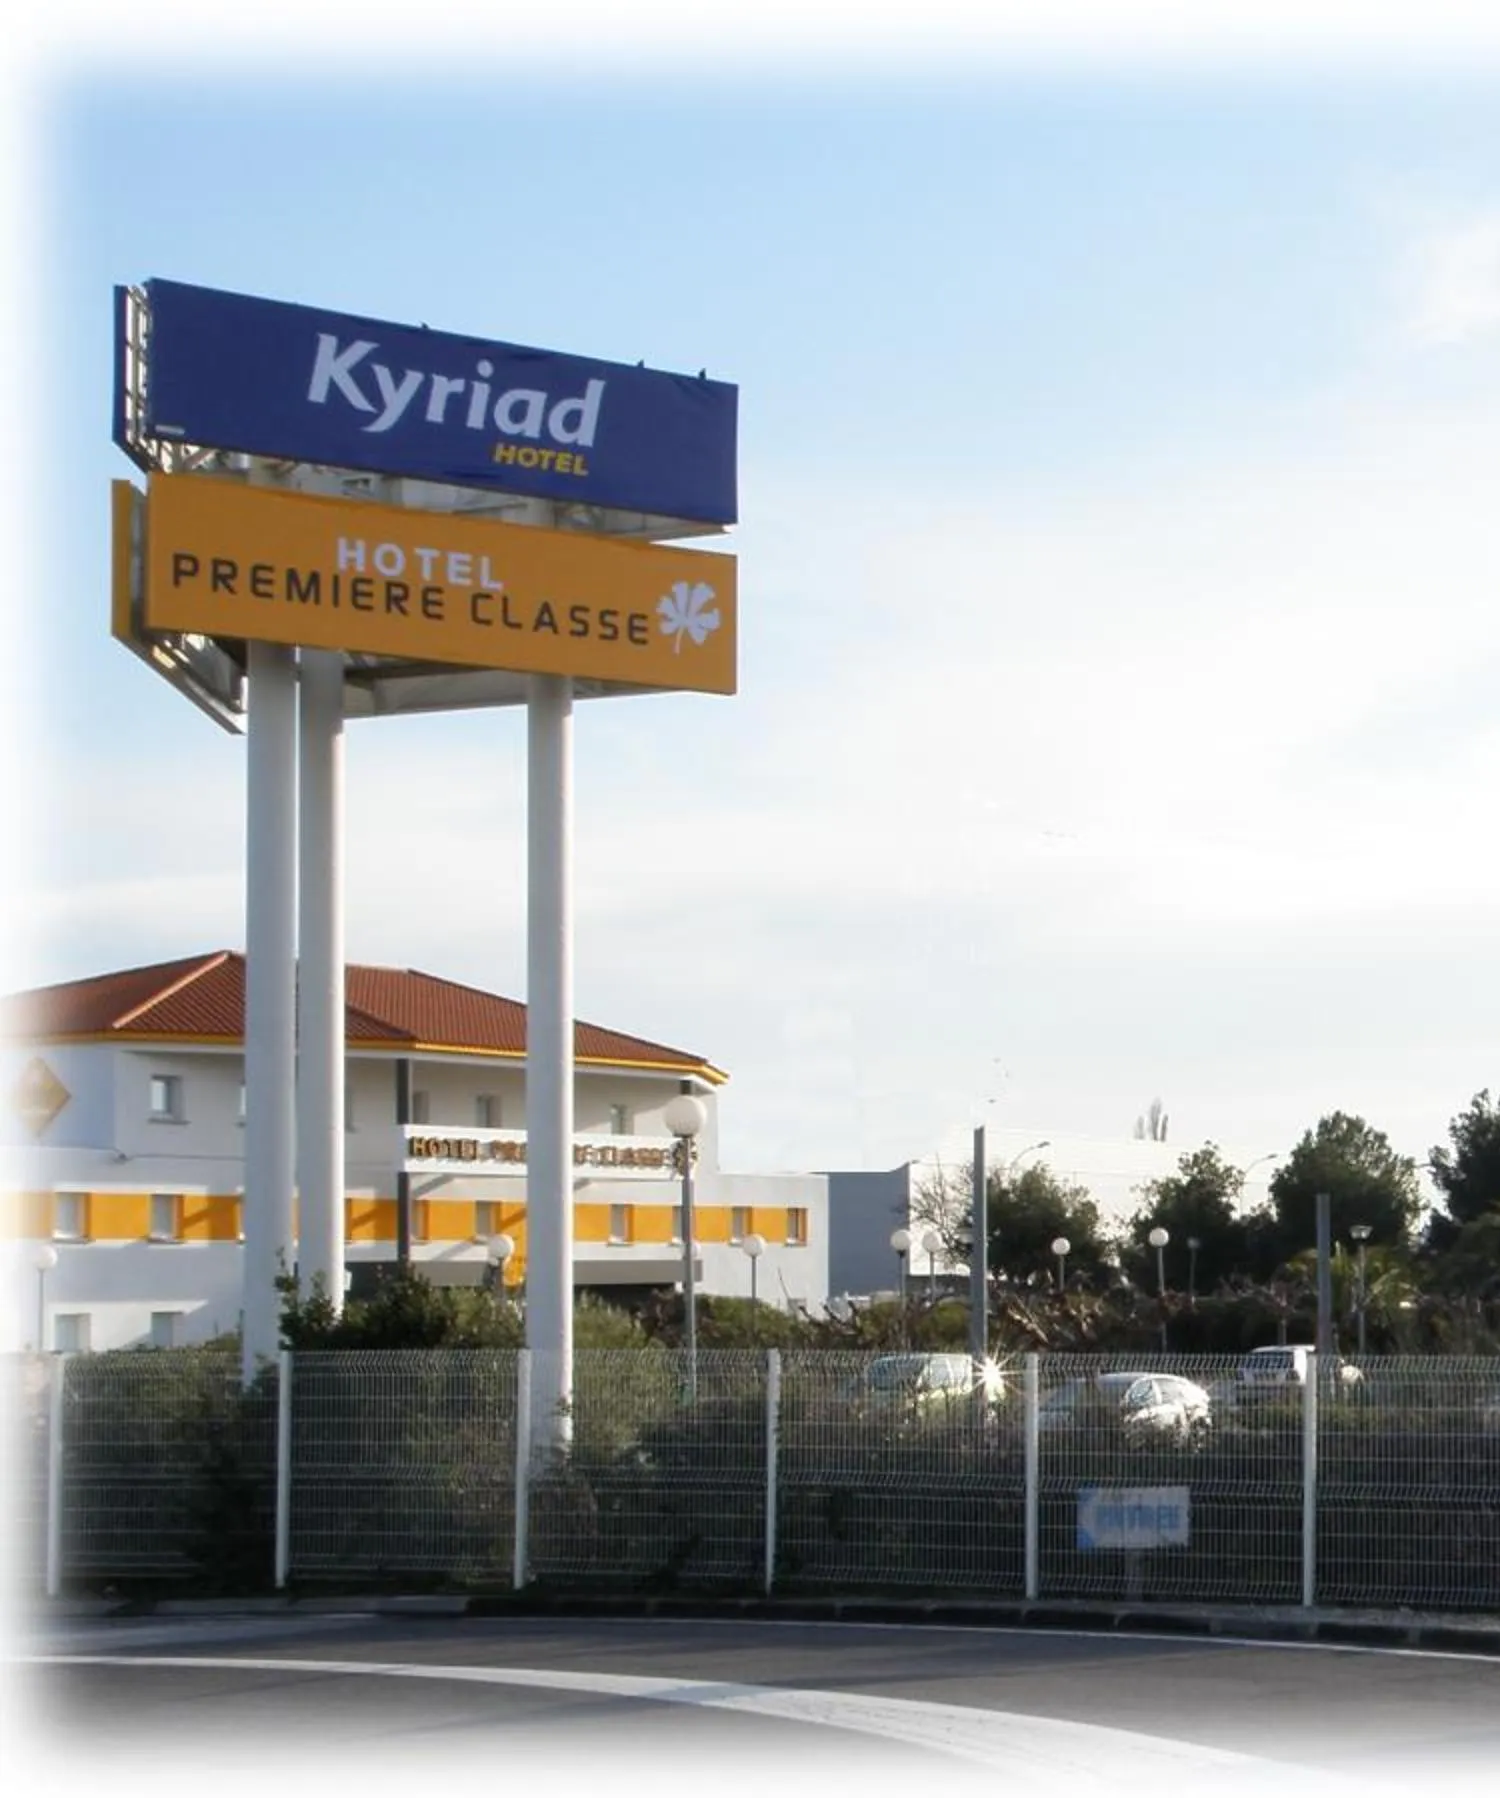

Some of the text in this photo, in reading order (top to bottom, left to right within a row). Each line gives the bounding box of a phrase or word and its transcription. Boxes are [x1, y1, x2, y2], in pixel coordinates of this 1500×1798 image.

[308, 333, 605, 447] Kyriad
[493, 443, 588, 476] HOTEL
[173, 553, 649, 645] PREMIERE CLASSE
[336, 537, 502, 590] HOTEL
